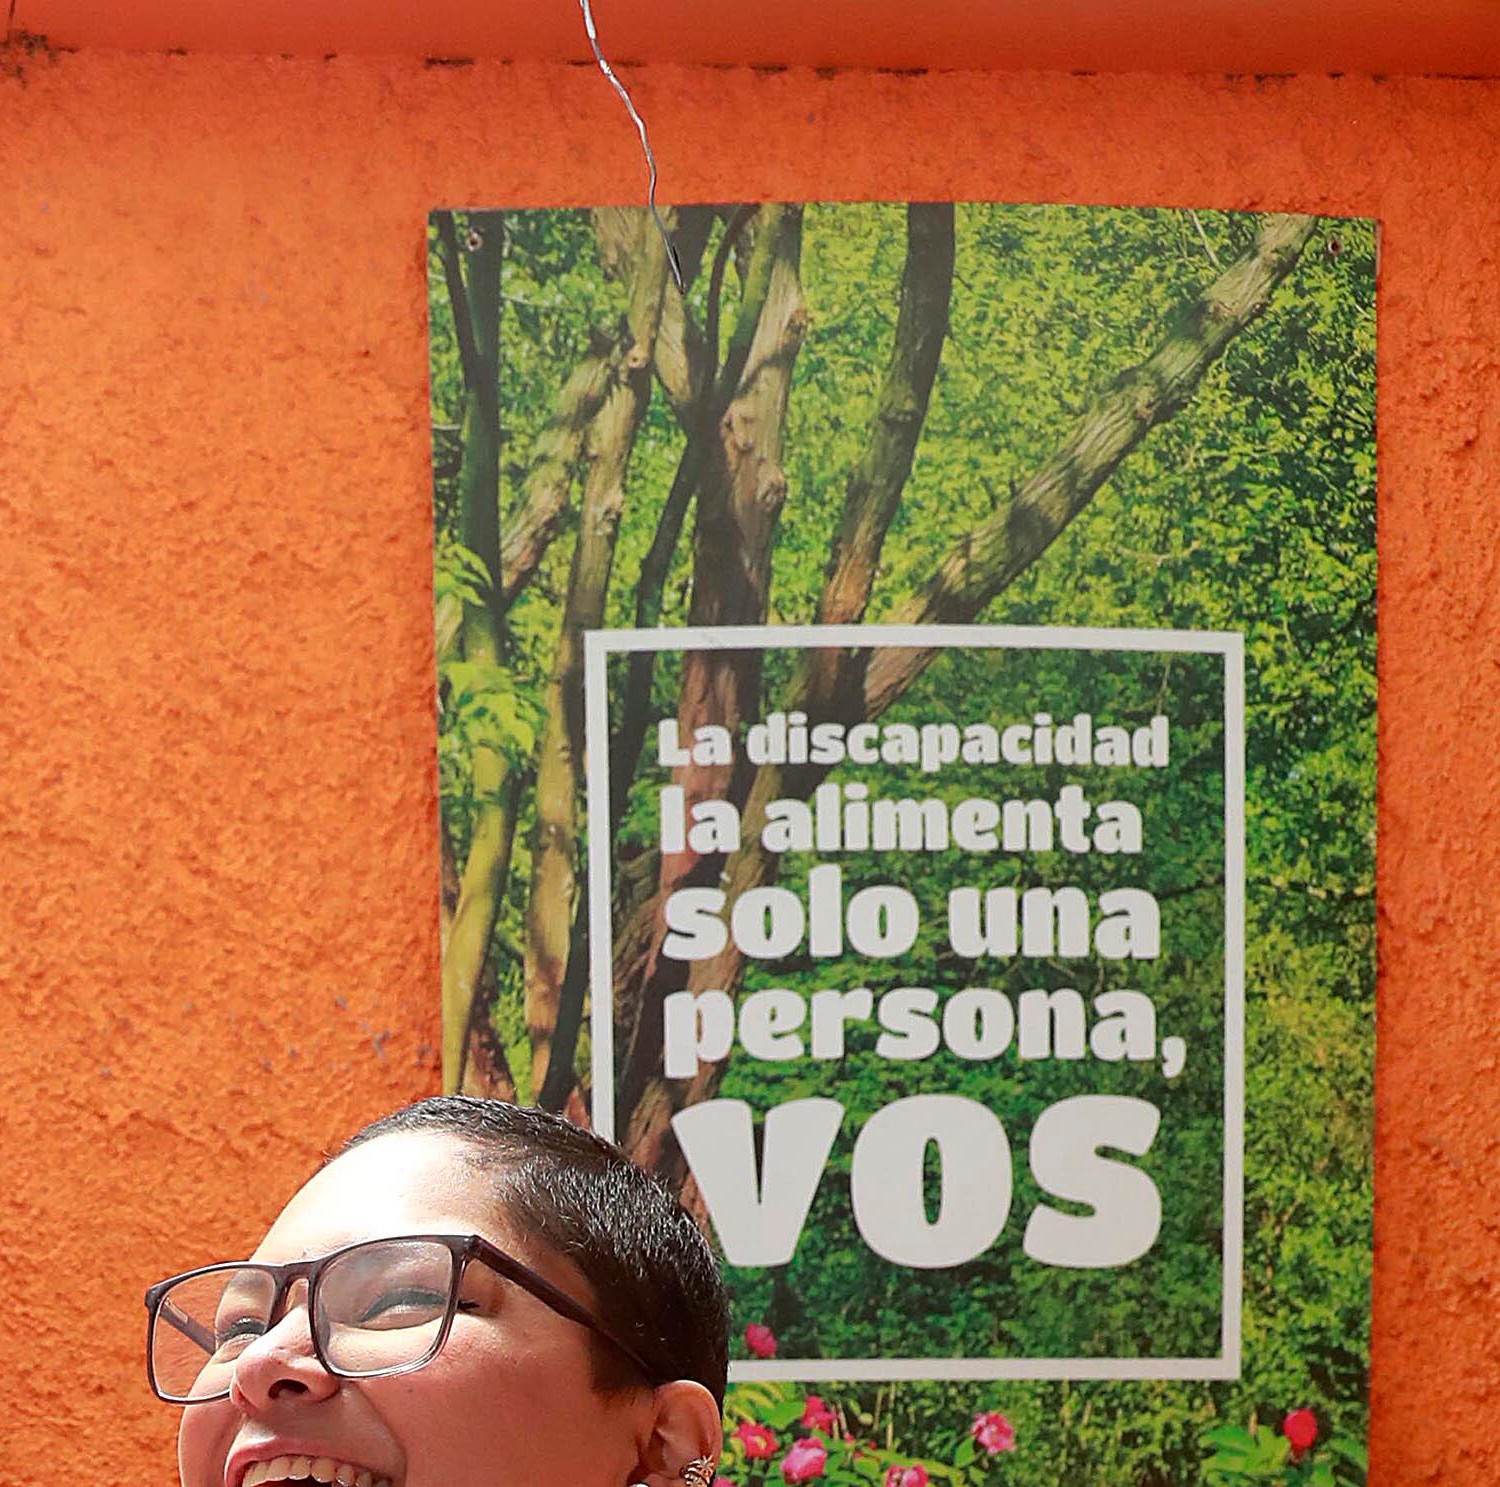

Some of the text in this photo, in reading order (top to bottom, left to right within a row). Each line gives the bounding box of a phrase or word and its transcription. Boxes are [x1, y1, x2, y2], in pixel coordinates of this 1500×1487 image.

[657, 712, 1170, 772] La discapacidad
[658, 784, 1143, 854] la alimenta
[662, 864, 1161, 961] solo una
[664, 987, 1188, 1080] persona,
